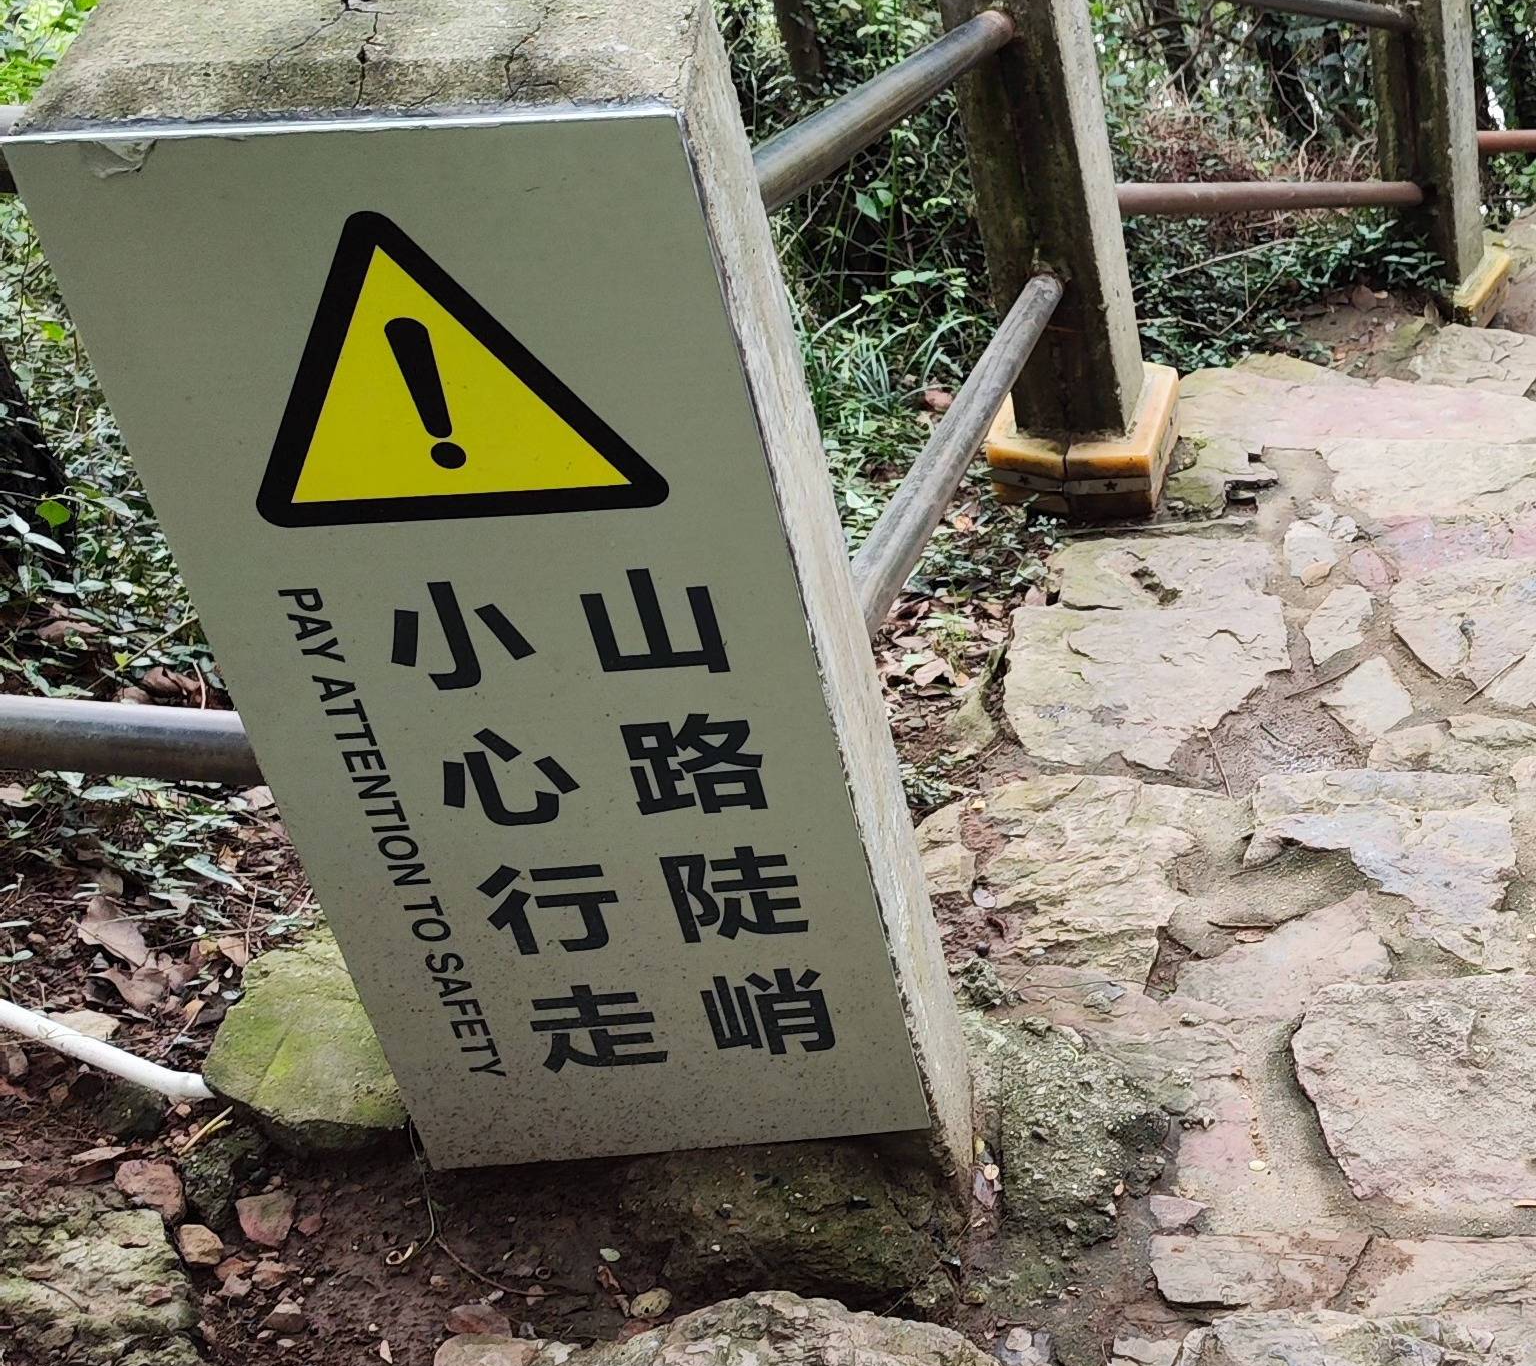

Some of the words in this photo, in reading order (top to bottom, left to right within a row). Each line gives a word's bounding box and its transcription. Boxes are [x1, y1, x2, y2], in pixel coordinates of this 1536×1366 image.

[278, 587, 346, 664] PAY
[311, 674, 431, 887] ATTENTION
[391, 581, 668, 1073] 小心行走
[580, 568, 836, 1055] 山路陡峭
[402, 895, 452, 942] TO
[425, 953, 507, 1078] SAFETY
